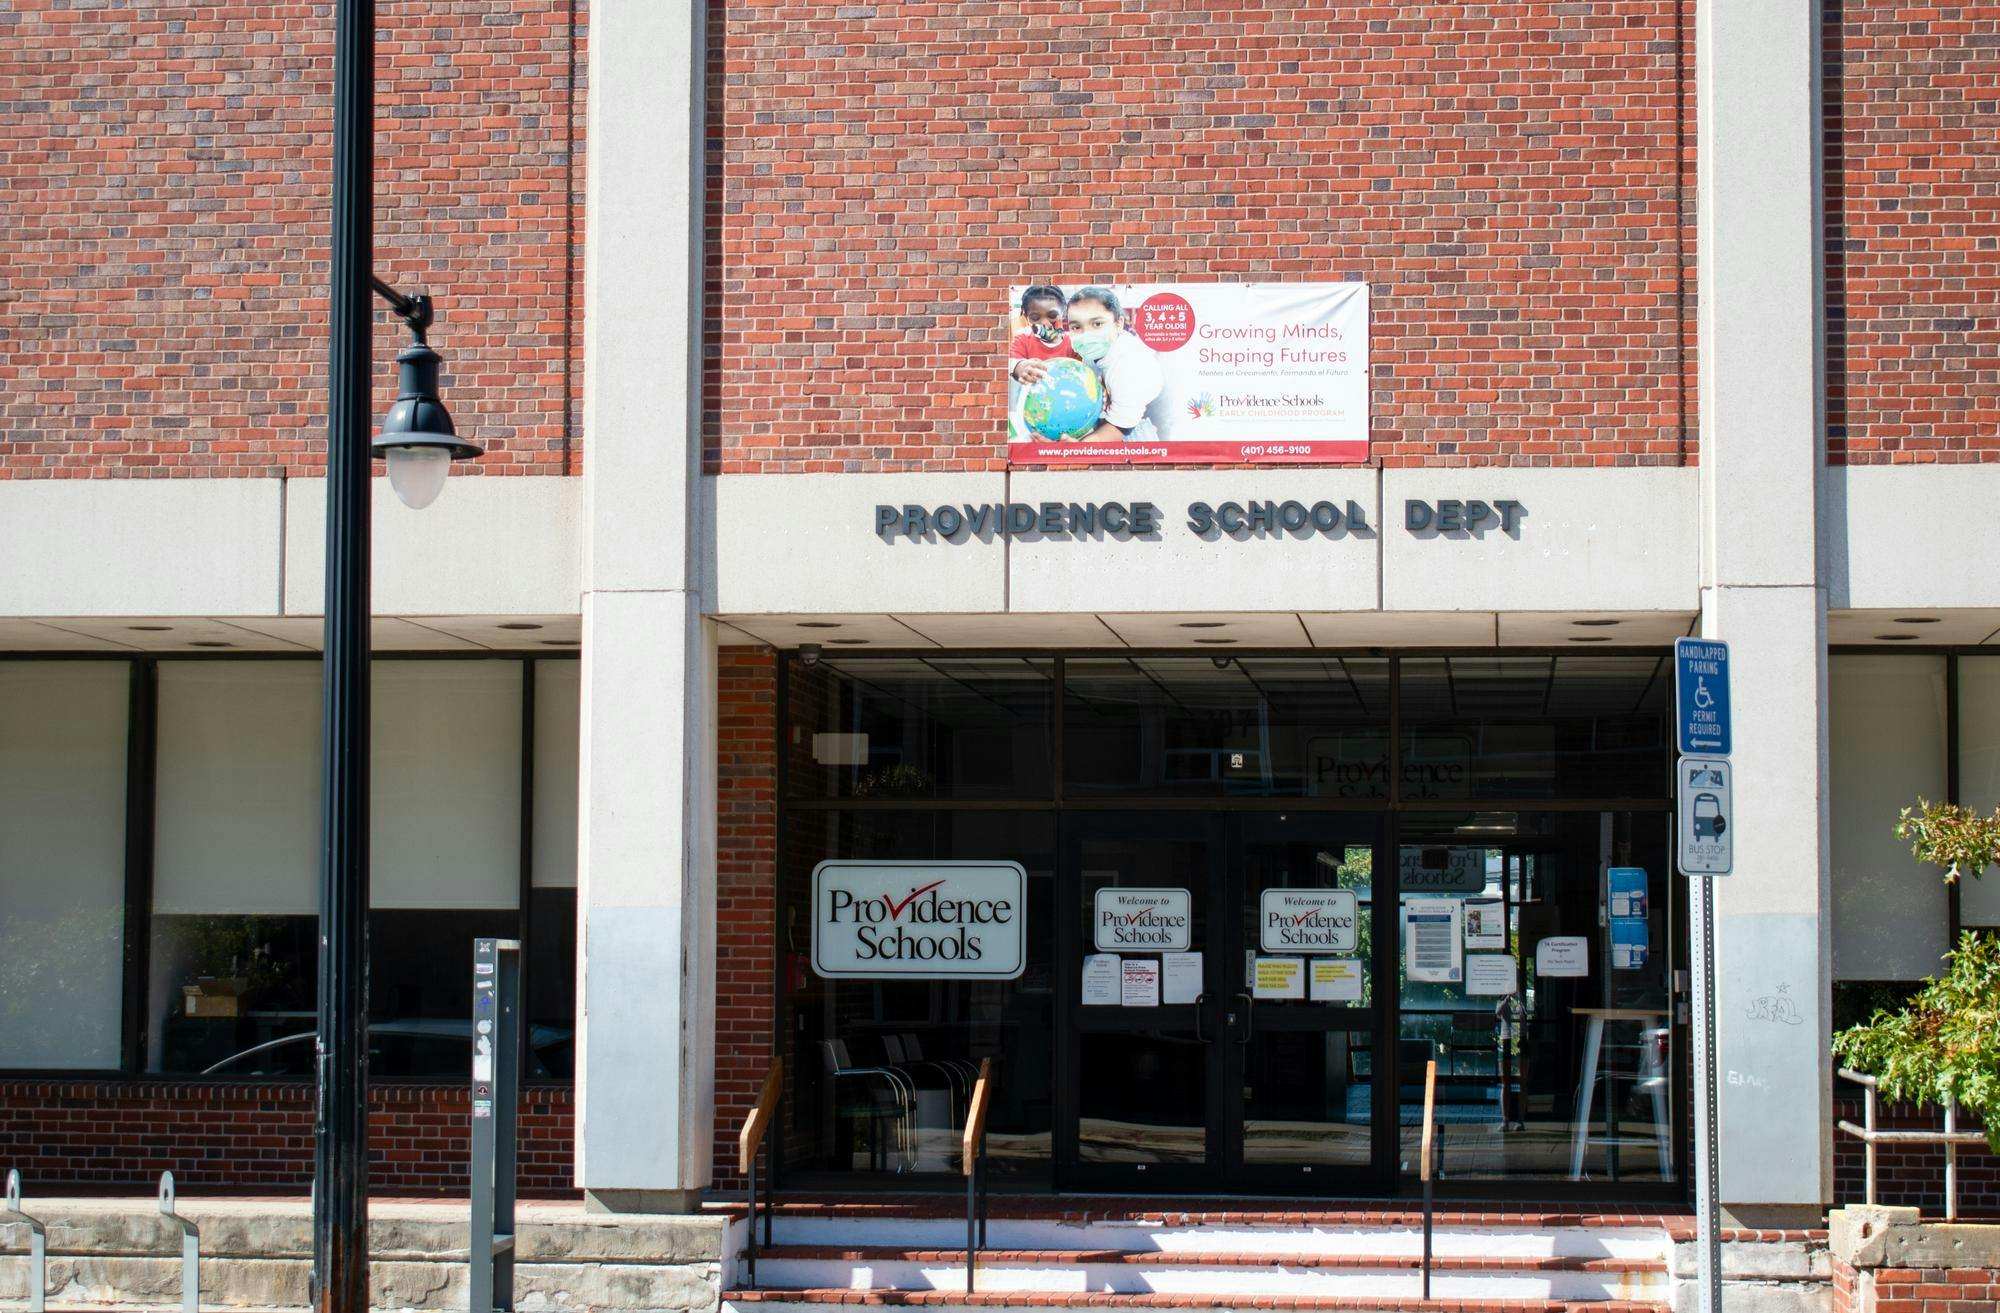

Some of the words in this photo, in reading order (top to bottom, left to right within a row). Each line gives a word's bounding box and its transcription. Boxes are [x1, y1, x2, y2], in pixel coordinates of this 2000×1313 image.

[1145, 312, 1155, 323] 3,
[1158, 312, 1166, 322] 4
[1178, 312, 1186, 322] 5
[1199, 323, 1276, 342] Growing
[1282, 322, 1344, 341] Minds,
[1198, 348, 1274, 367] Shaping
[1280, 348, 1347, 363] Futures
[1220, 395, 1280, 407] Providence
[1282, 394, 1324, 407] Schools
[1038, 445, 1168, 457] www.providenceschools.org
[1240, 444, 1264, 456] (401)
[1266, 444, 1311, 455] 456-9100
[875, 502, 1154, 536] PROVIDENCE
[1187, 499, 1368, 534] SCHOOL
[1403, 498, 1520, 532] DEPT
[1688, 660, 1718, 675] PARKING
[1692, 710, 1716, 722] PERMIT
[1688, 722, 1721, 736] REQUIRED
[1689, 844, 1706, 854] BUS
[1707, 845, 1725, 855] STOP
[827, 880, 1012, 924] Providence
[1118, 896, 1158, 906] Welcome
[1160, 896, 1170, 906] to
[1284, 896, 1324, 906] Welcome
[1327, 897, 1336, 906] to
[1102, 908, 1185, 928] Providence
[1268, 908, 1352, 928] Providence
[856, 926, 982, 961] Schools
[1114, 928, 1172, 944] Schools
[1280, 929, 1339, 945] Schools
